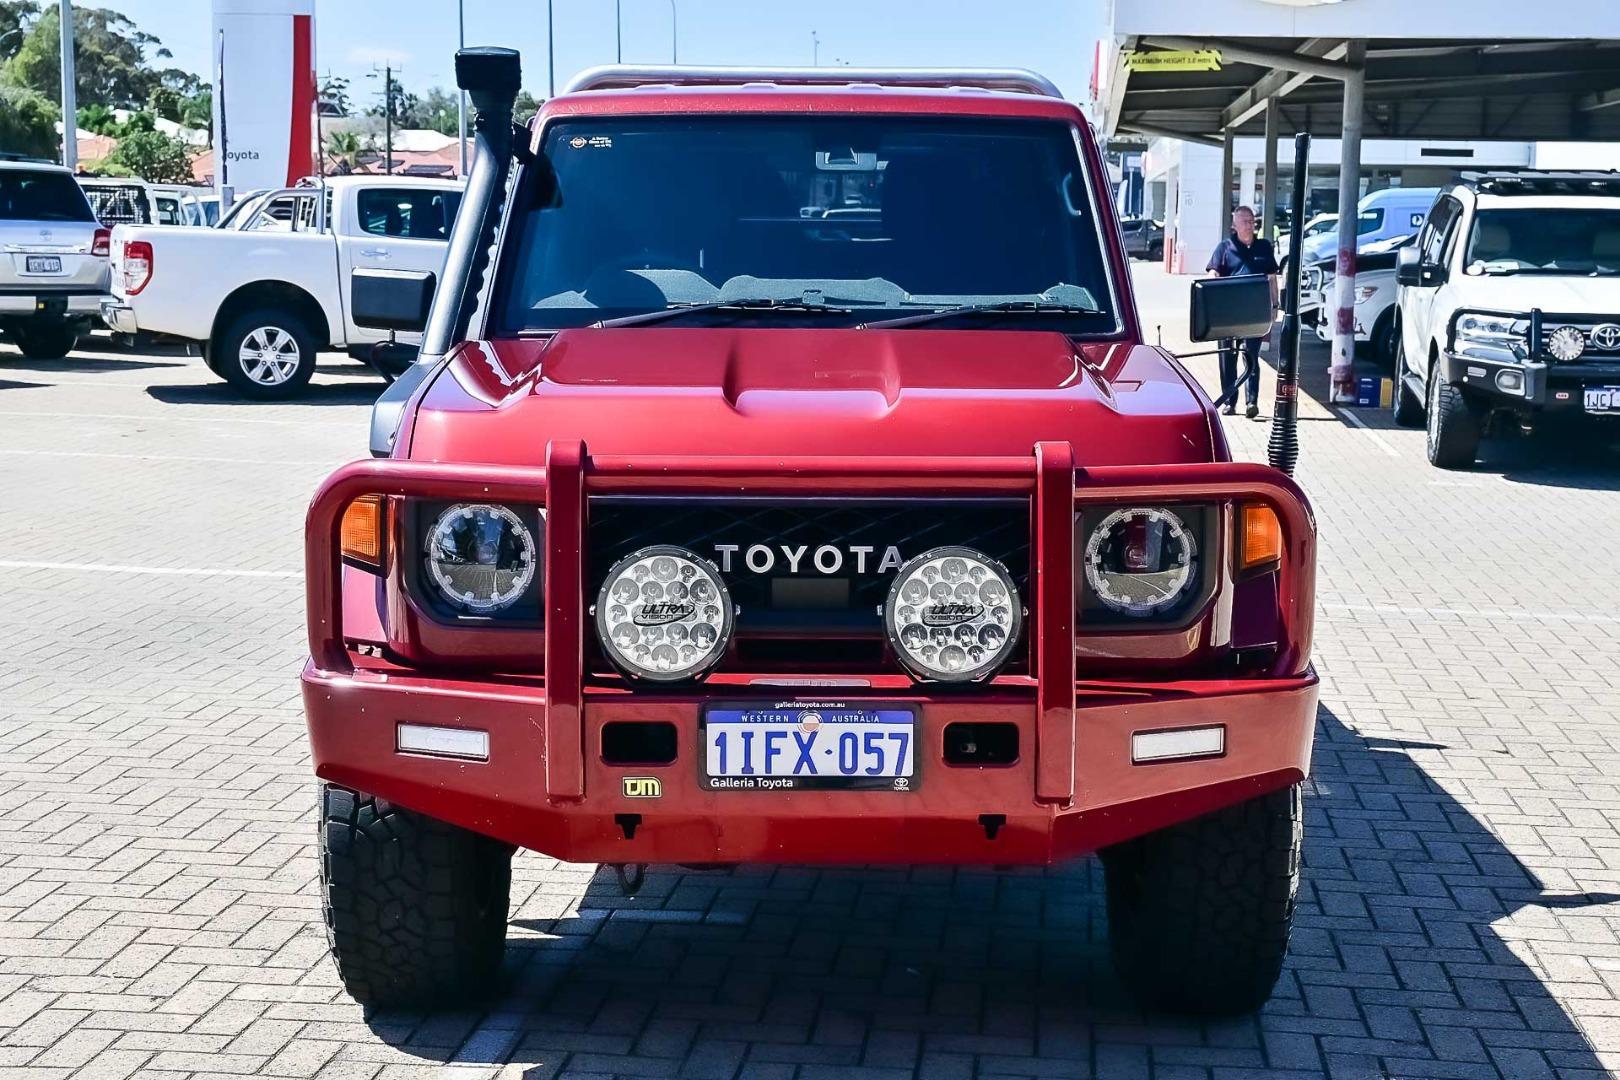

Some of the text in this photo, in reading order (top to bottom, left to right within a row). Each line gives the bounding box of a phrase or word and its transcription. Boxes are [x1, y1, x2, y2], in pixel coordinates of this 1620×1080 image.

[1131, 57, 1162, 65] MAXIMUM
[1163, 57, 1186, 65] HEIGHT
[226, 150, 260, 162] oyota
[714, 544, 903, 574] TOYOTA
[641, 601, 686, 614] ULTRA
[931, 601, 975, 615] ULTRA
[774, 701, 846, 709] galleriatoyota.com.au
[741, 714, 881, 723] WESTERN AUSTRALIA
[710, 777, 794, 789] Galleria Toyota
